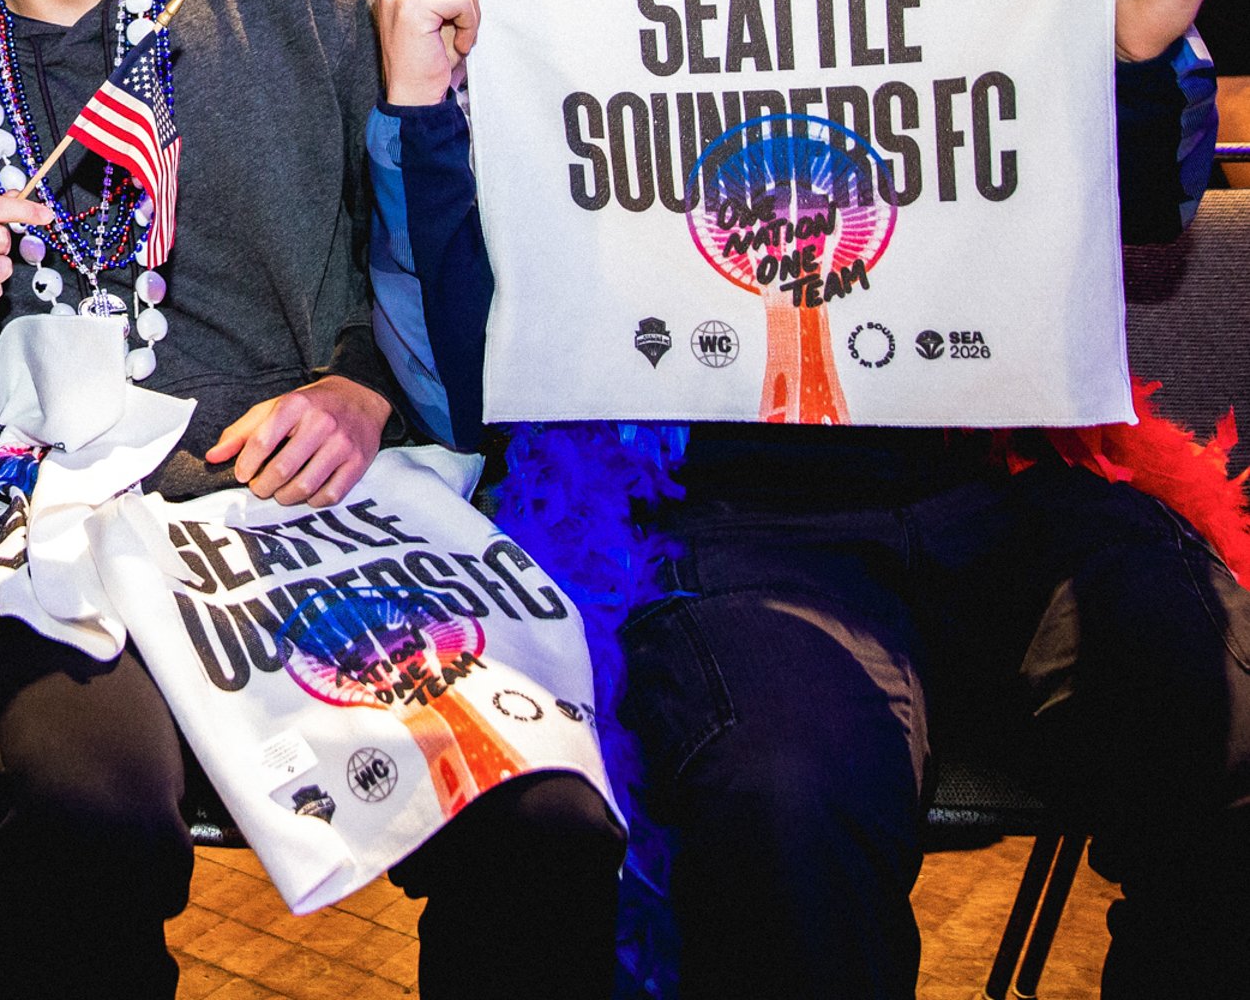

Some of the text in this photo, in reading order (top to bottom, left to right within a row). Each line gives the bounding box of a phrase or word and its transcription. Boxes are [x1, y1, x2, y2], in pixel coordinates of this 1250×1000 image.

[562, 71, 1018, 214] SOUNDERS FC
[717, 195, 776, 230] ONE
[722, 201, 837, 257] NATION
[756, 244, 819, 285] ONE
[779, 258, 870, 308] TEAM
[698, 335, 732, 353] WC
[949, 331, 985, 344] SEA
[950, 345, 991, 359] 2026
[448, 540, 568, 621] FC
[375, 661, 427, 705] ONE
[403, 651, 488, 706] TEAM
[354, 758, 389, 792] WC
